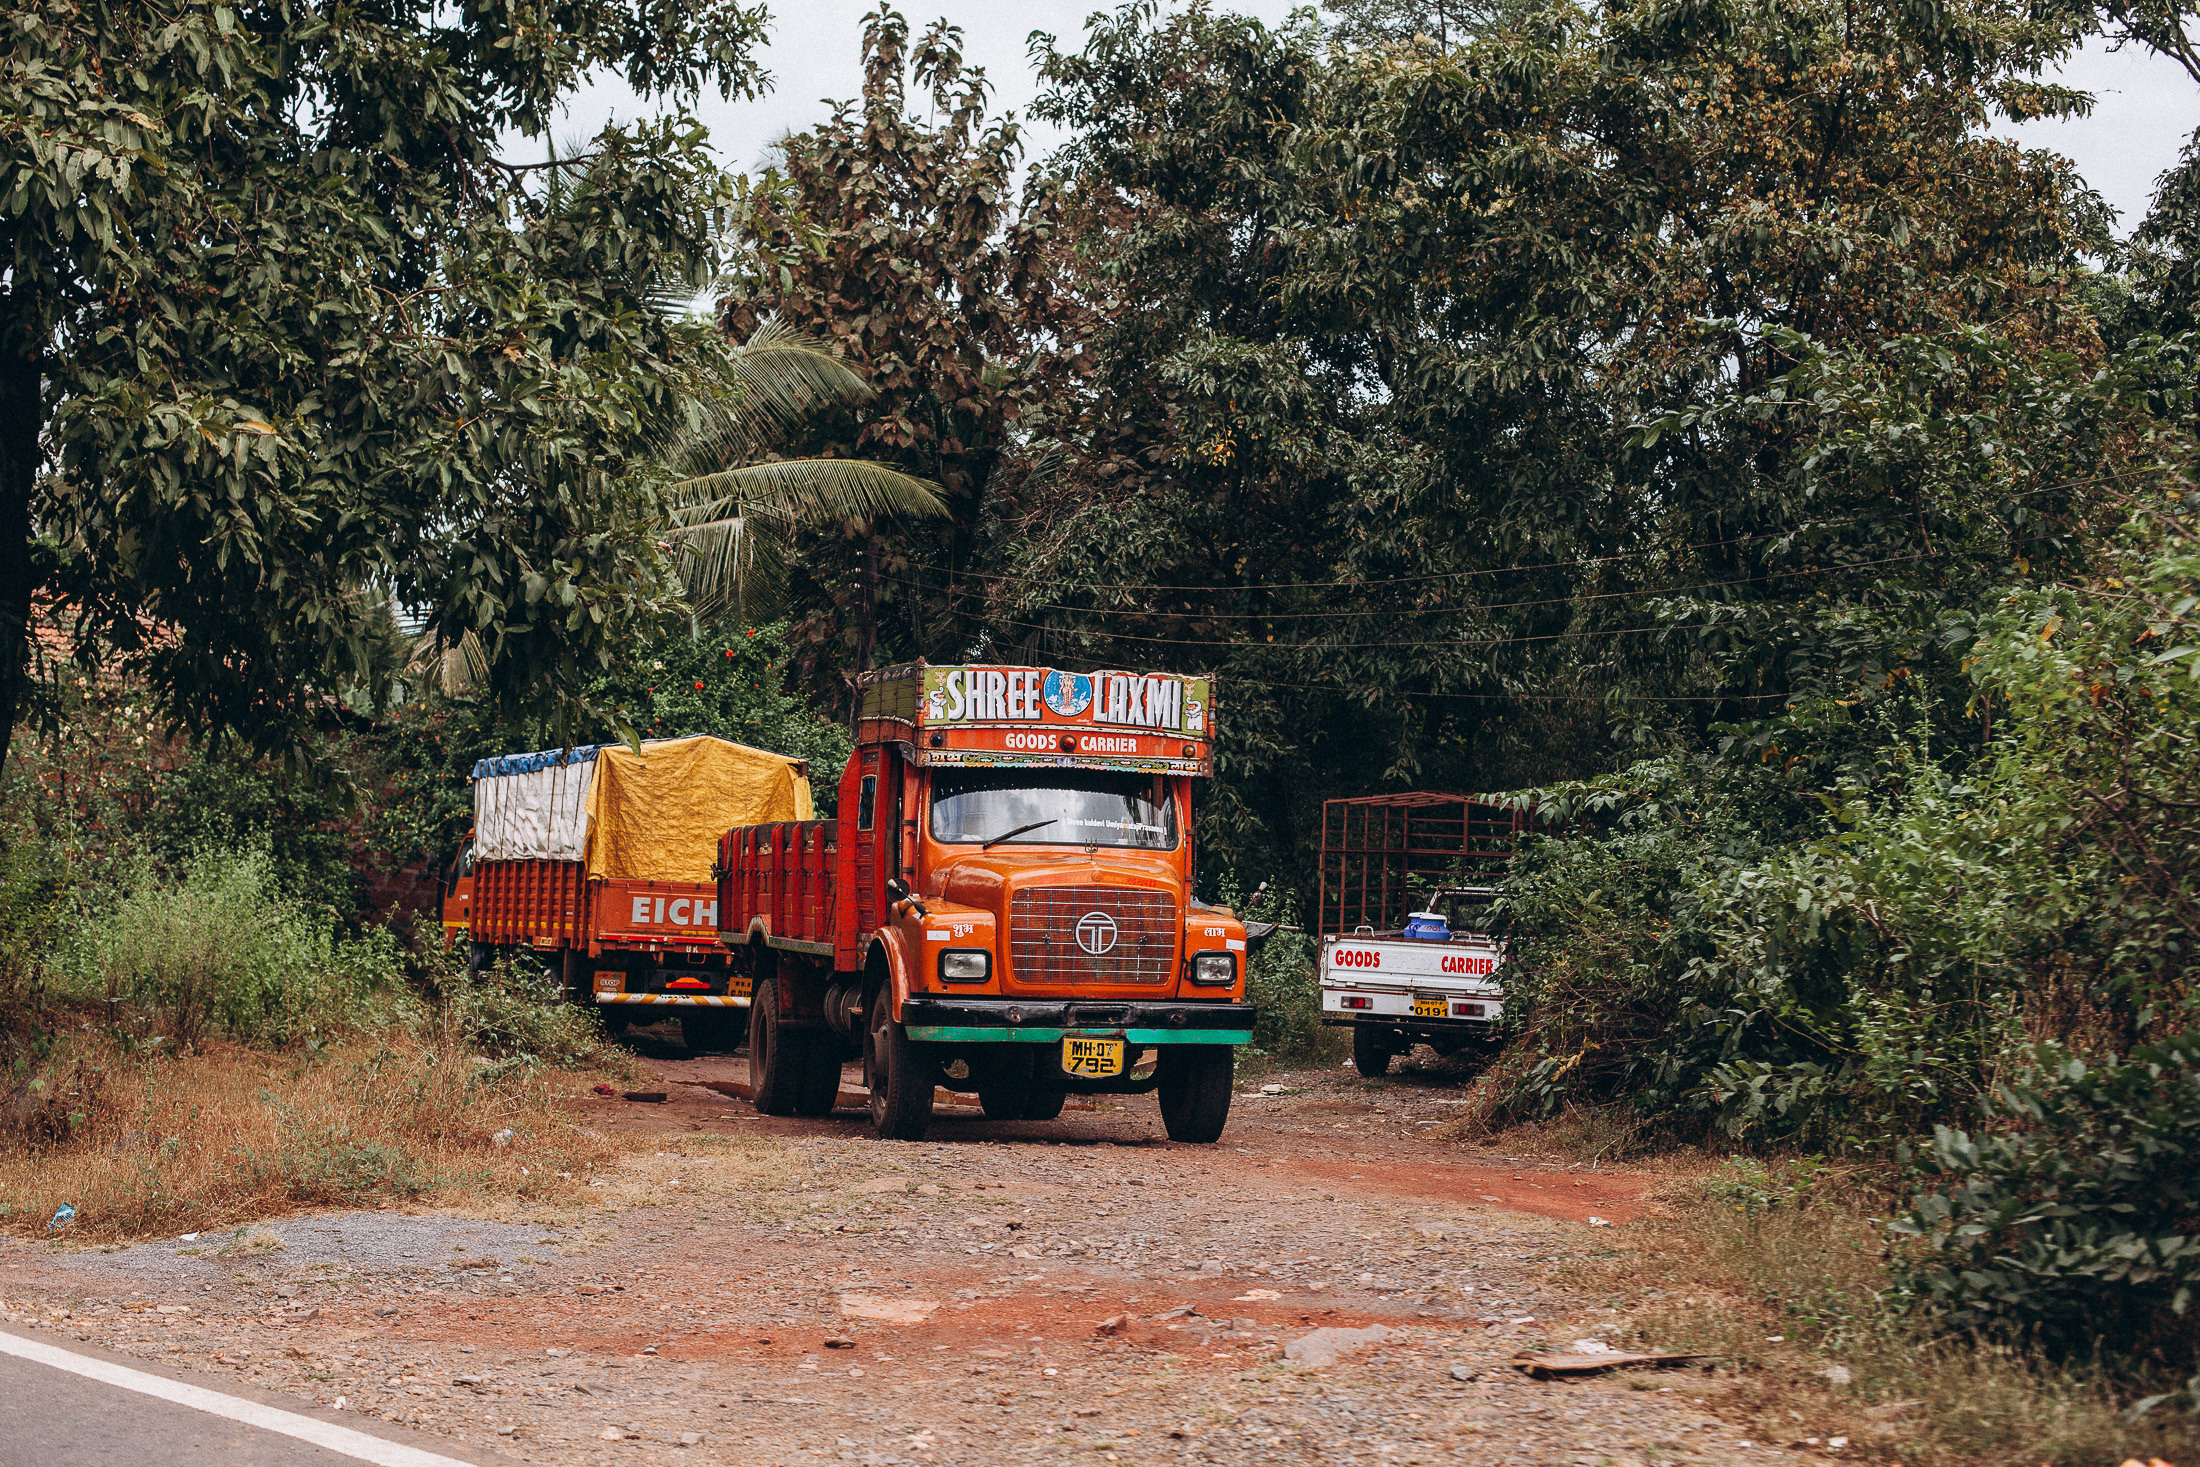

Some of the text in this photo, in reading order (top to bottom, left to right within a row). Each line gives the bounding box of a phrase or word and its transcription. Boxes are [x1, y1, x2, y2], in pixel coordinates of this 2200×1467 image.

[946, 670, 1182, 729] SHREE LAXMI
[1005, 733, 1137, 753] GOODS CARRIER
[632, 896, 718, 927] EICH
[953, 923, 975, 938] शुभ
[1204, 927, 1226, 938] लाभ
[1335, 950, 1381, 968] GOODS
[1441, 956, 1494, 975] CARRIER
[1415, 1006, 1448, 1017] 0191
[1071, 1057, 1114, 1073] 792
